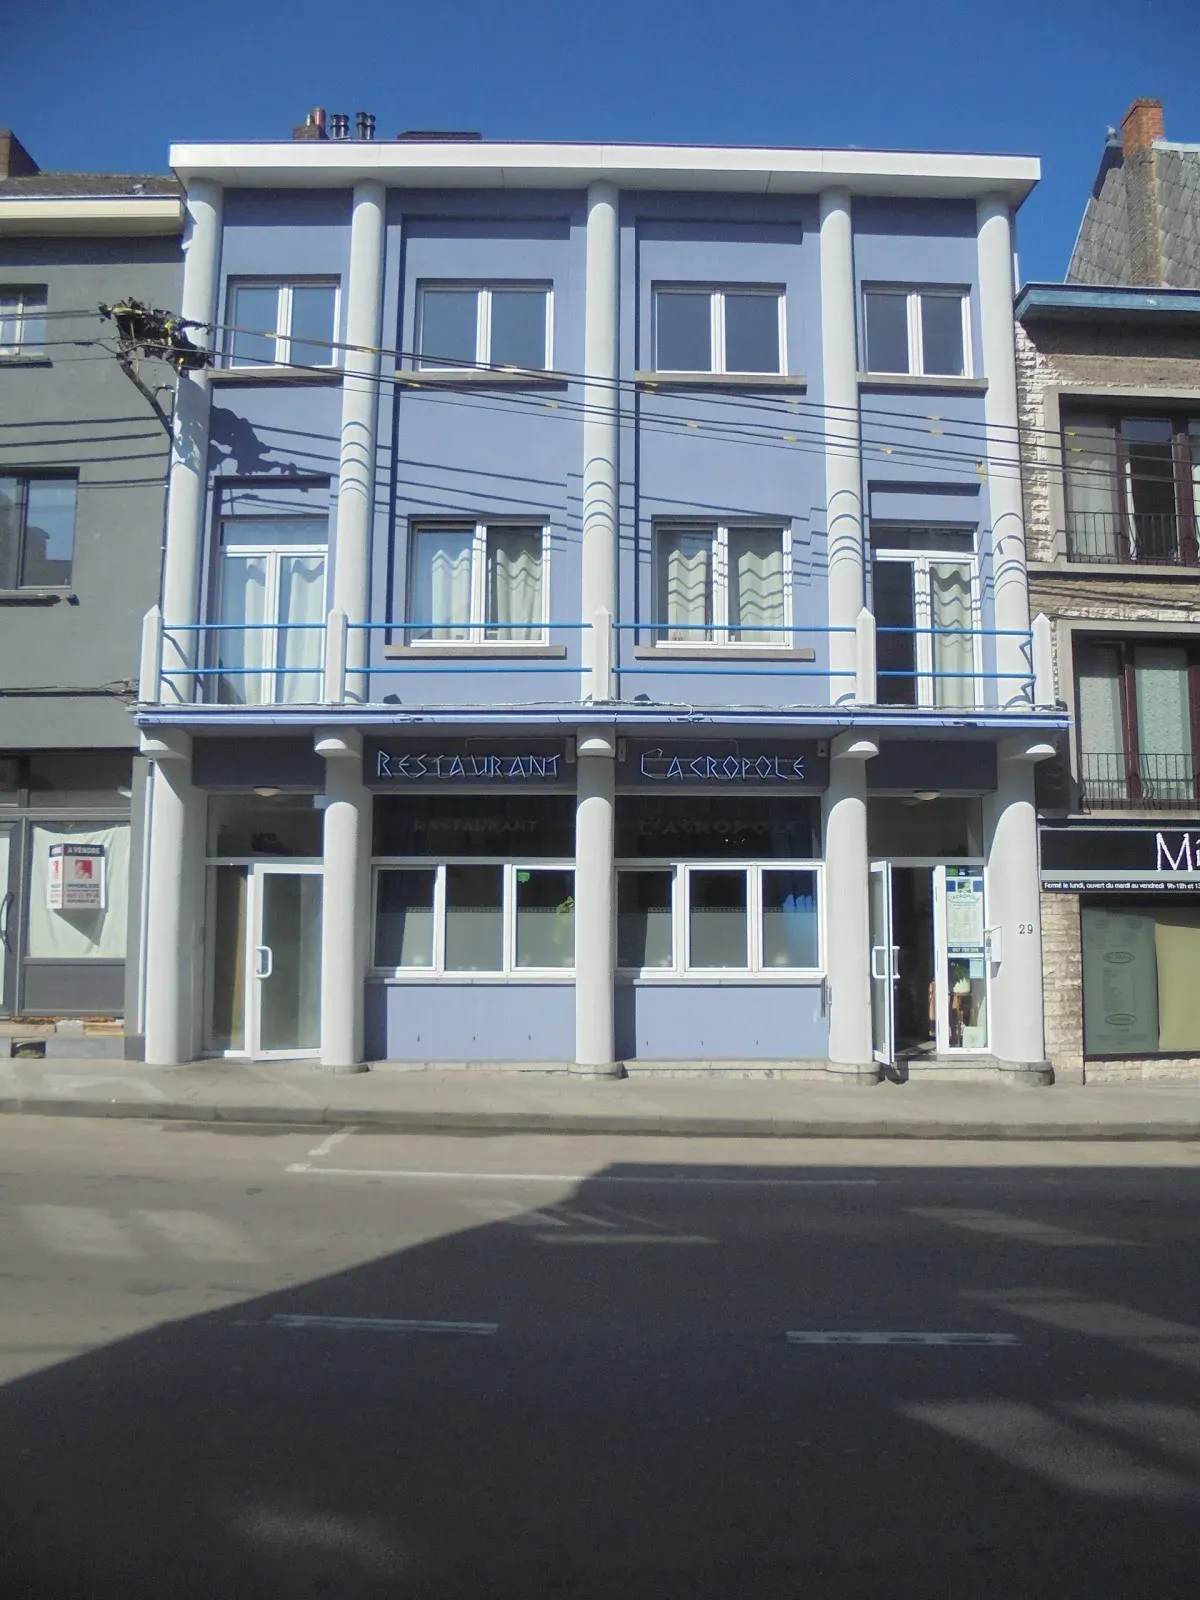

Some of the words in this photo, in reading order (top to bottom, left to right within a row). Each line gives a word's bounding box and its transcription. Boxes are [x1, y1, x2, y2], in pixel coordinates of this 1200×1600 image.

[377, 750, 561, 778] RESTAURANT
[641, 748, 804, 780] L'ACROPOLE
[1018, 923, 1034, 935] 29
